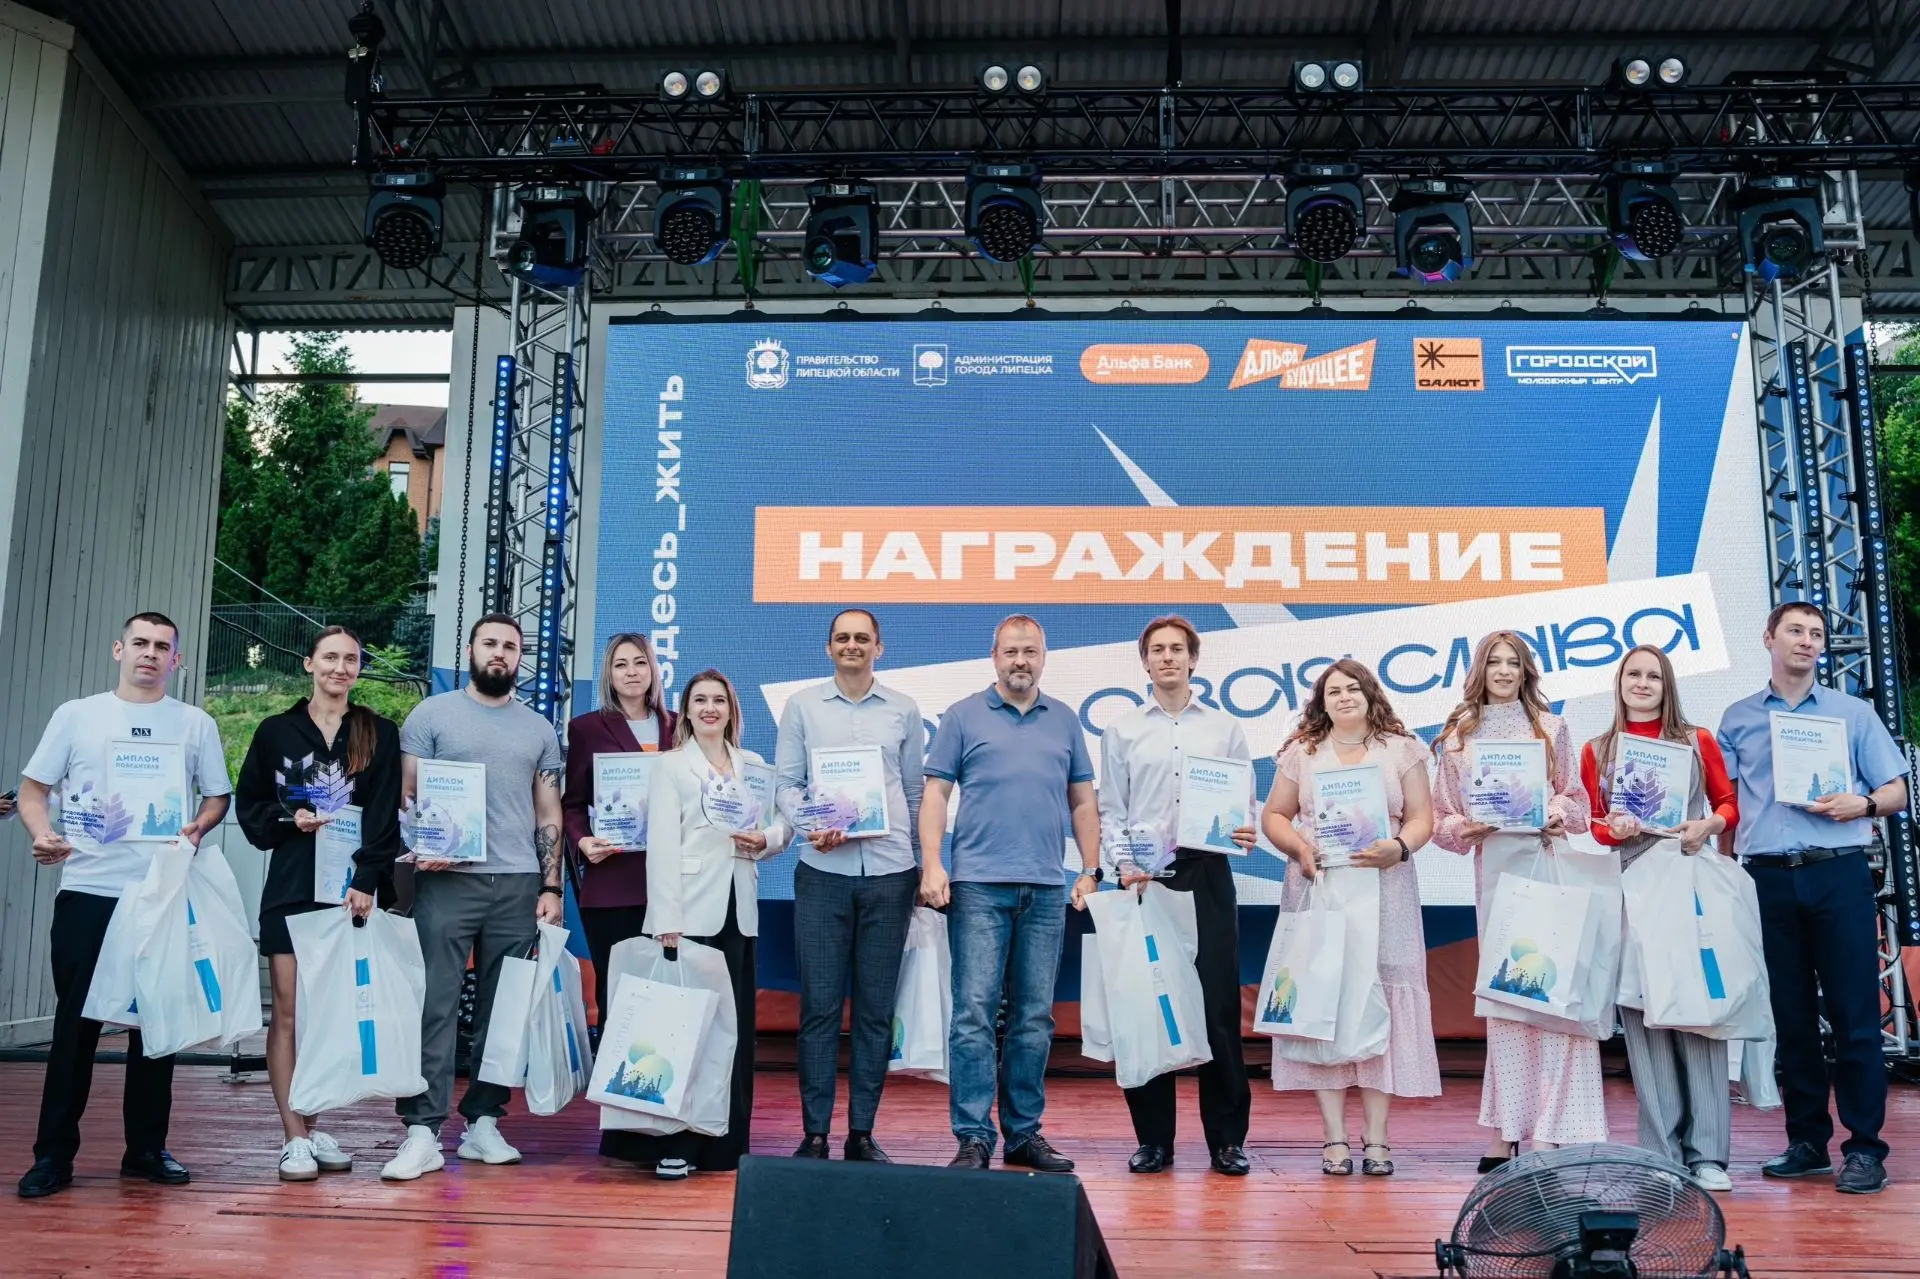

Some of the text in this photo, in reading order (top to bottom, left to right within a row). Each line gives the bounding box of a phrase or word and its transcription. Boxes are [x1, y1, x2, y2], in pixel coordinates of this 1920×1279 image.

[796, 355, 879, 365] ПРАВИТЕЛЬСТВО
[954, 355, 1053, 365] АДМИНИСТРАЦИЯ
[1097, 354, 1193, 373] Альфа Банк
[1242, 348, 1299, 380] АЛЬФА
[1515, 354, 1648, 368] ГОРОДСКОЙ
[796, 366, 900, 378] ЛИПЕЦКОЙ ОБЛАСТИ
[955, 365, 1053, 375] ГОРОДА ЛИПЕЦКА
[1286, 349, 1367, 388] БУДУЩЕЕ
[1418, 378, 1481, 388] САЛЮТ
[1592, 377, 1624, 385] ЦЕНТР
[798, 530, 1564, 588] НАГРАЖДЕНИЕ
[1780, 728, 1821, 738] ДИПЛОМ
[116, 754, 159, 762] ДИПЛОМ
[1626, 749, 1667, 762] ДИПЛОМ
[821, 760, 860, 769] ДИПЛОМ
[602, 767, 641, 775] ДИПЛОМ
[1190, 767, 1228, 779] ДИПЛОМ
[426, 776, 463, 785] ДИПЛОМ
[1321, 780, 1361, 791] ДИПЛОМ
